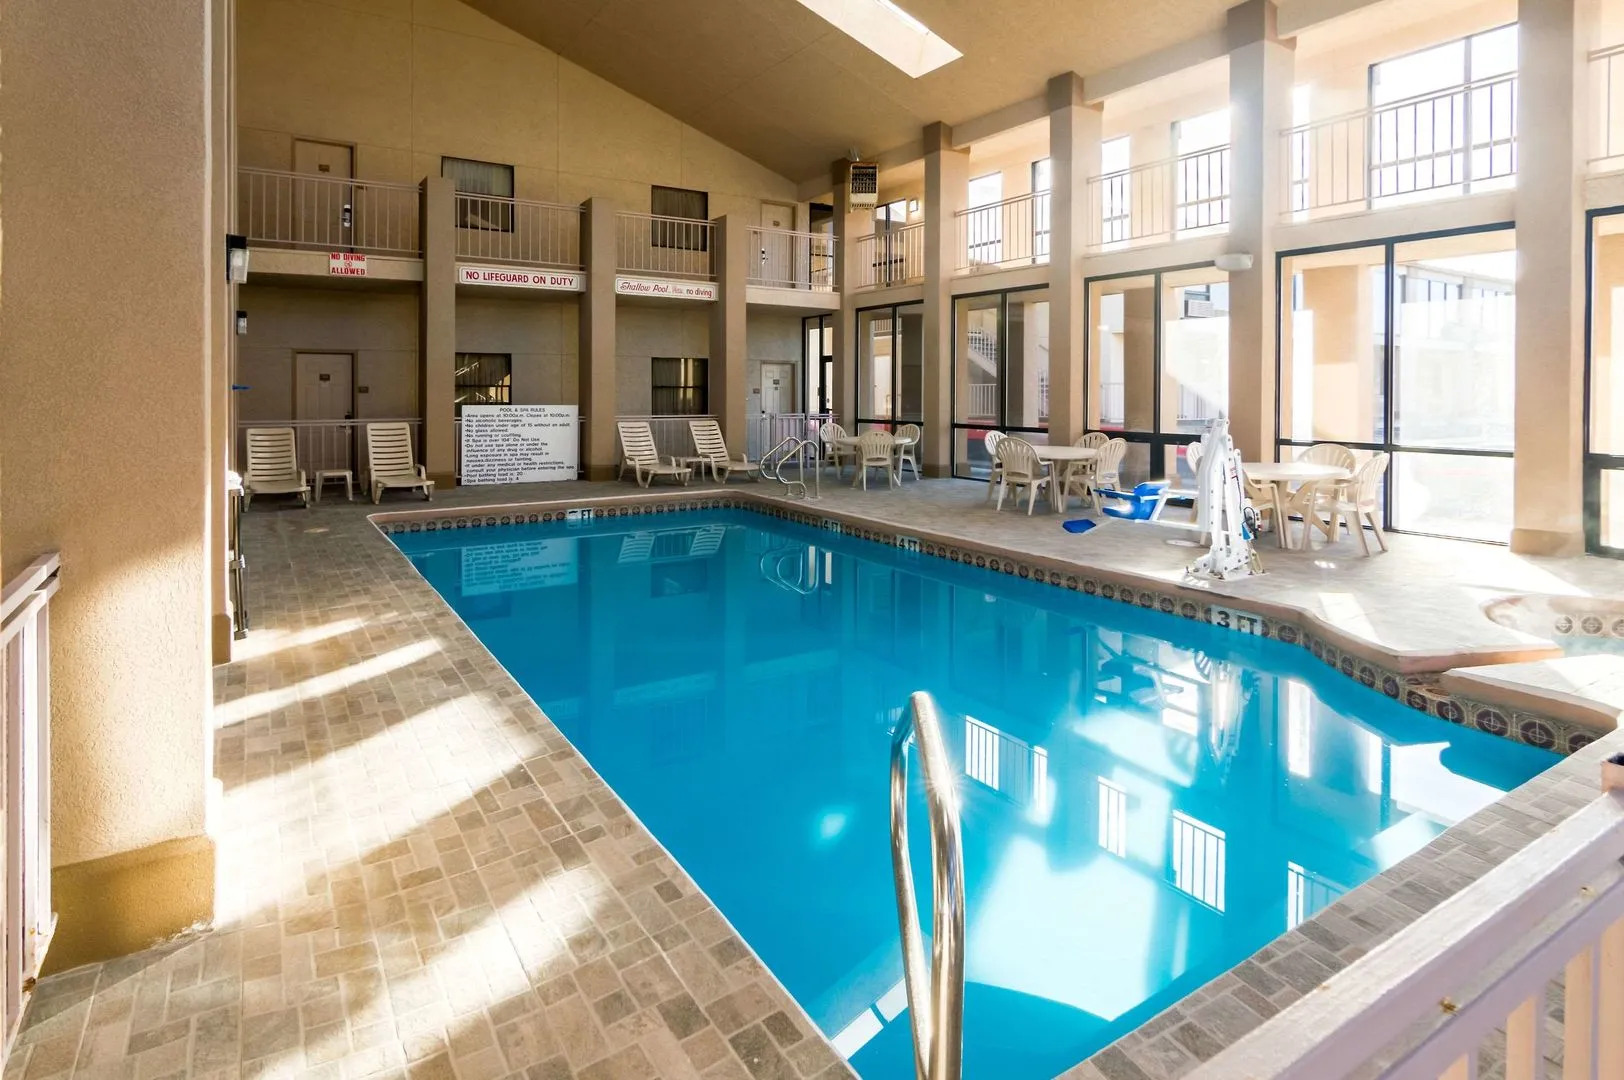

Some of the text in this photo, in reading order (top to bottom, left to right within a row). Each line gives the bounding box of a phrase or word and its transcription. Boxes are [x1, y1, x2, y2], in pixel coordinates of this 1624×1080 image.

[343, 253, 366, 261] DIVING
[331, 267, 366, 275] ALLOWED
[466, 271, 574, 286] NO LIFEGUARD ON DUTY
[620, 282, 651, 292] Shallow
[695, 288, 712, 298] diving
[581, 509, 592, 519] FT
[899, 538, 917, 552] 4 FT
[1217, 611, 1258, 635] 3 FT
